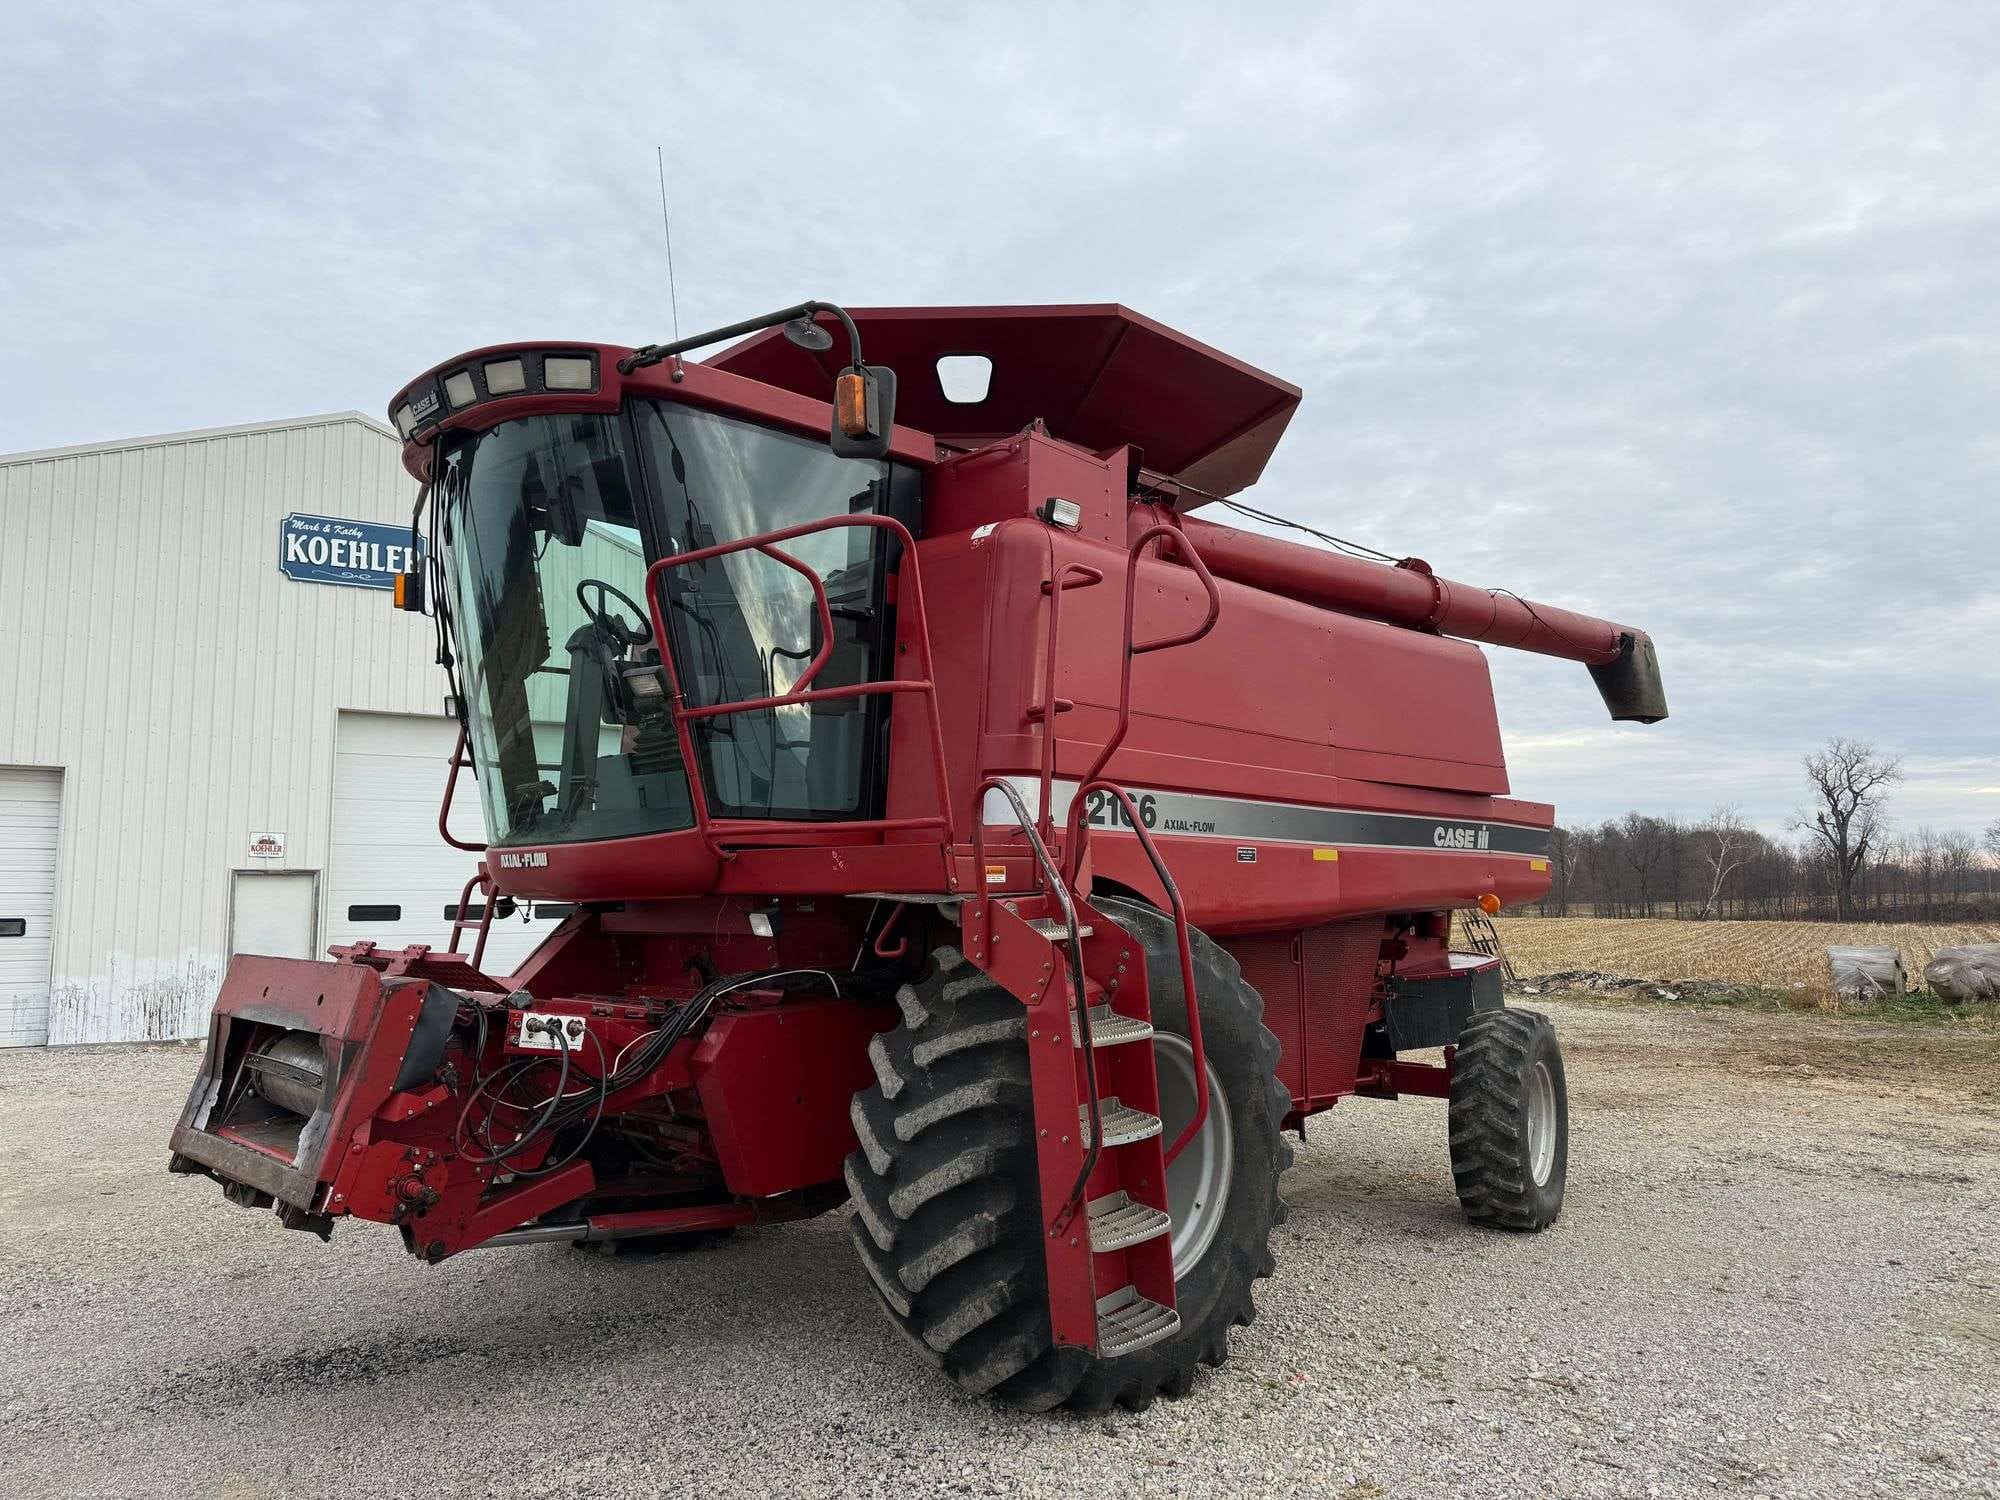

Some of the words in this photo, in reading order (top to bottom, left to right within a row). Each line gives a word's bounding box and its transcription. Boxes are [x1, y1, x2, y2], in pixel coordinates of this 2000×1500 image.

[412, 396, 431, 416] CASE
[292, 519, 320, 531] Mark
[322, 523, 331, 533] &
[334, 525, 364, 539] Kathy
[1433, 826, 1475, 849] CASE
